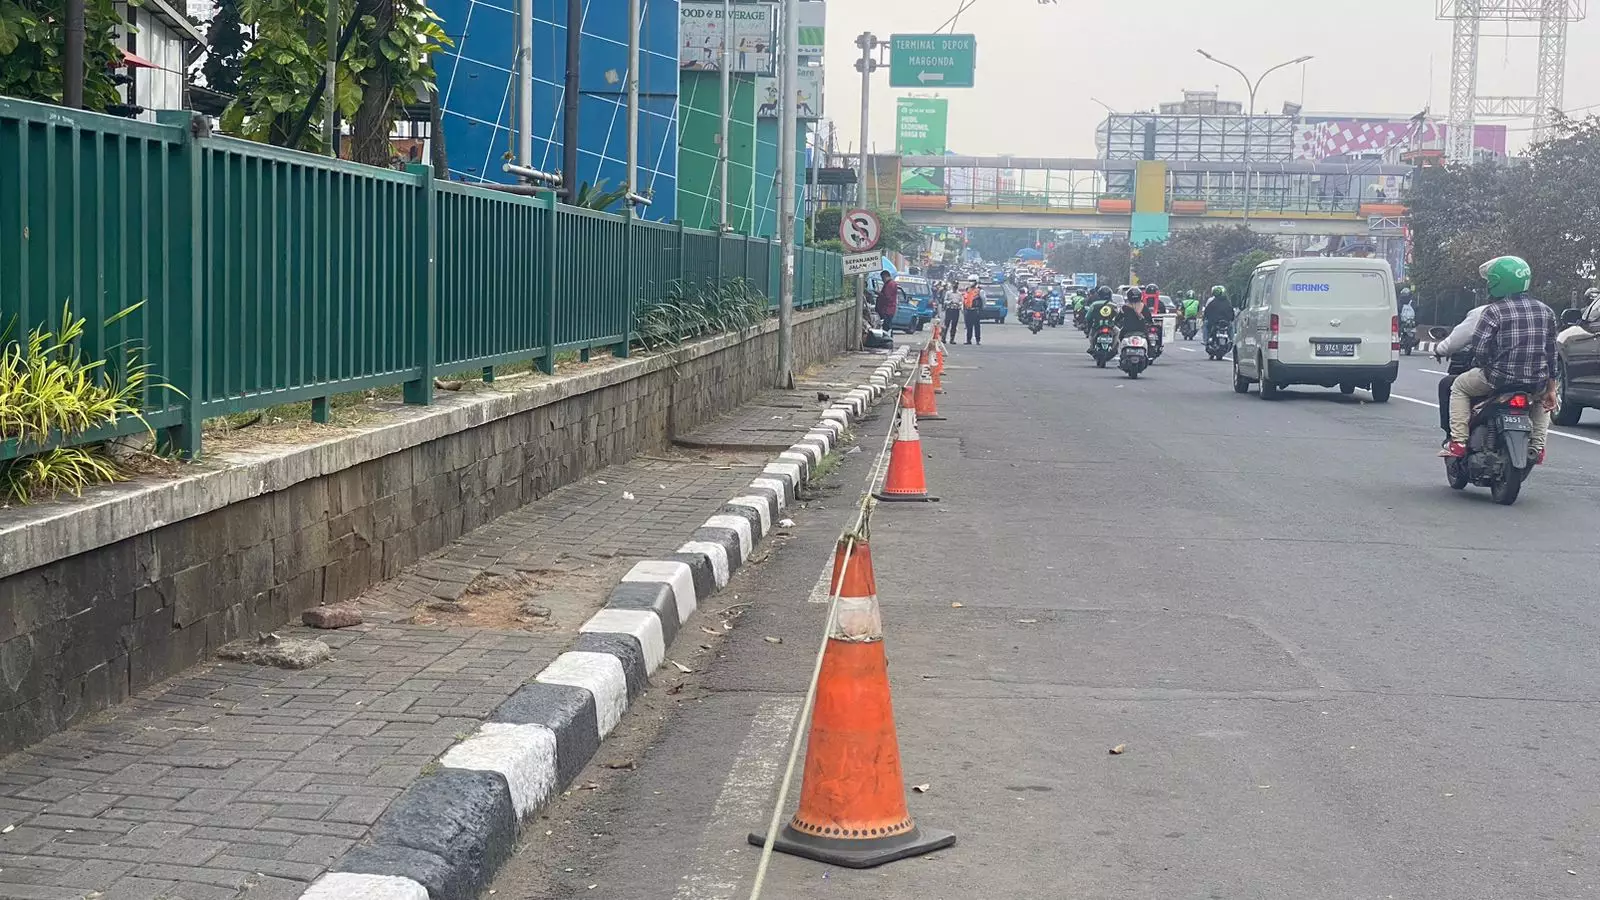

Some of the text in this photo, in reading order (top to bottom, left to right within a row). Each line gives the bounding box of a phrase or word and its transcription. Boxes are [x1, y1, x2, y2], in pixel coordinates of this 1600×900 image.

[706, 10, 714, 19] &
[895, 40, 969, 50] TERMINAL DEPOK
[908, 56, 954, 66] MARGONDA
[1295, 283, 1330, 292] BRINKS
